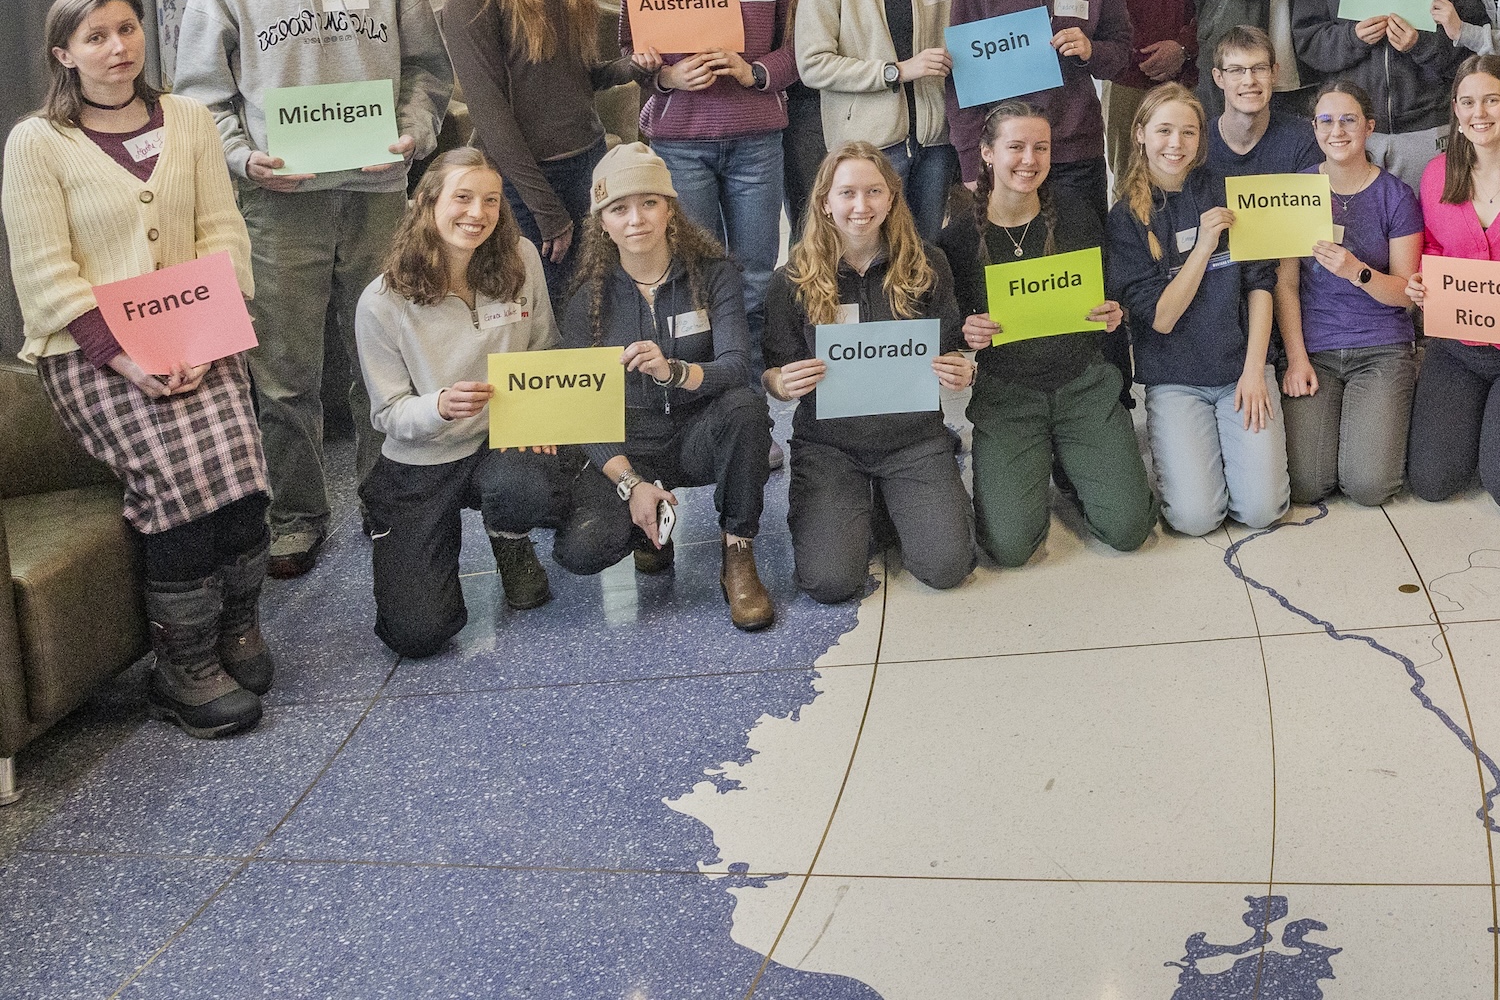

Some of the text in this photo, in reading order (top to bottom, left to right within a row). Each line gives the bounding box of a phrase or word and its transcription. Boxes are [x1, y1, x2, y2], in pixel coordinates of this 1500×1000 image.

[970, 31, 1030, 60] Spain
[278, 102, 382, 125] Michigan
[1237, 192, 1321, 210] Montana
[1009, 270, 1082, 297] Florida
[122, 284, 210, 321] France
[1455, 308, 1496, 328] Rico
[828, 338, 928, 361] Colorado
[508, 372, 606, 392] Norway
